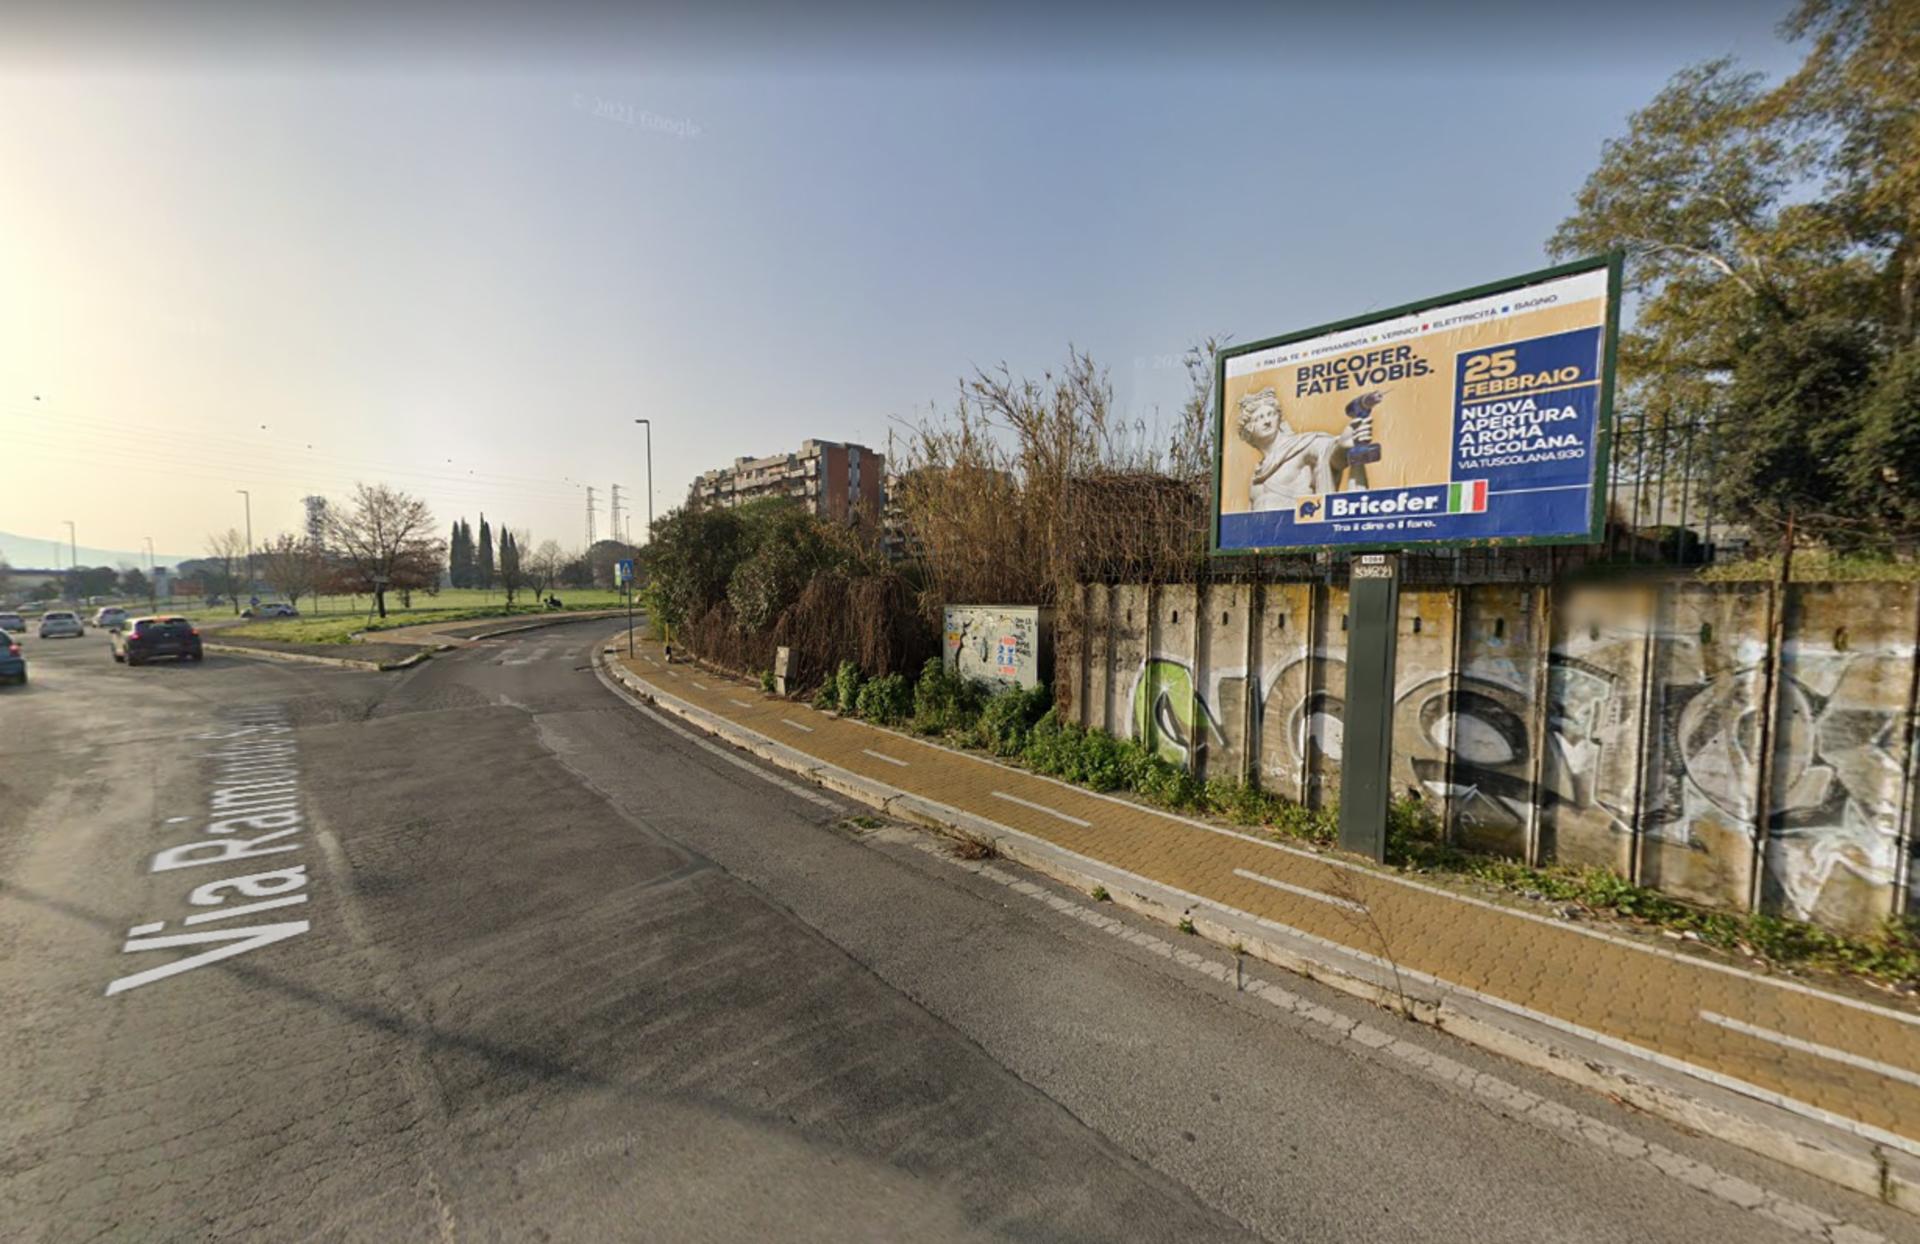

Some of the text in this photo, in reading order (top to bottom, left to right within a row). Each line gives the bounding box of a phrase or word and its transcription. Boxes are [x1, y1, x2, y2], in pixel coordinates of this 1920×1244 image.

[1290, 352, 1300, 361] TE
[1382, 327, 1418, 340] VERNICI
[1515, 294, 1558, 311] BAGNO
[1297, 345, 1417, 382] BRICOFER.
[1463, 349, 1518, 383] 25
[1295, 359, 1435, 399] FATE VOBIS.
[1463, 366, 1580, 398] FEBBRAIO
[1460, 405, 1577, 433] APERTURA
[1461, 398, 1538, 421] NUOVA
[1459, 424, 1543, 445] A ROMA
[1459, 434, 1583, 458] TUSCOLANA.
[1458, 449, 1585, 469] VIA TUSCOLANA 930
[1331, 491, 1439, 517] Bricofer
[1332, 523, 1351, 532] Tra
[1361, 521, 1385, 532] dire
[1386, 521, 1396, 530] e
